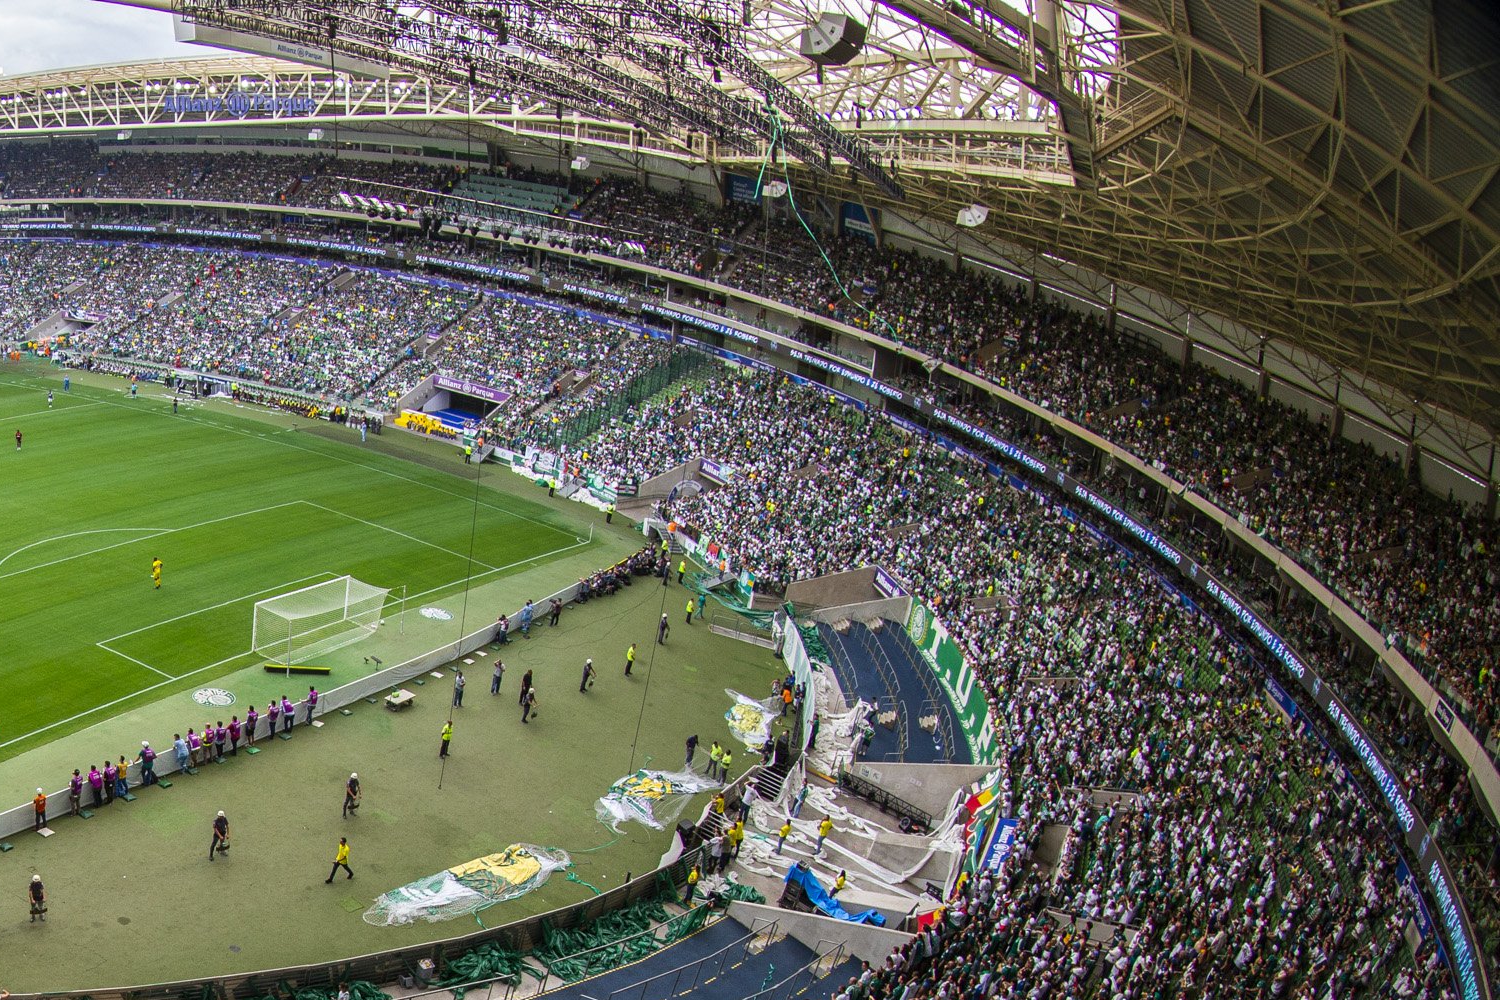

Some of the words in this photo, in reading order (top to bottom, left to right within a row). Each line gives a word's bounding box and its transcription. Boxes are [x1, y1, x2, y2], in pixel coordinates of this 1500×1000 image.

[277, 44, 297, 55] Allianz
[304, 50, 323, 61] Parque
[163, 95, 223, 114] Allianz
[252, 96, 317, 116] Parque
[437, 378, 462, 392] Allianz
[471, 387, 495, 400] Parque
[875, 572, 893, 595] Allianz
[998, 824, 1014, 844] Allianz
